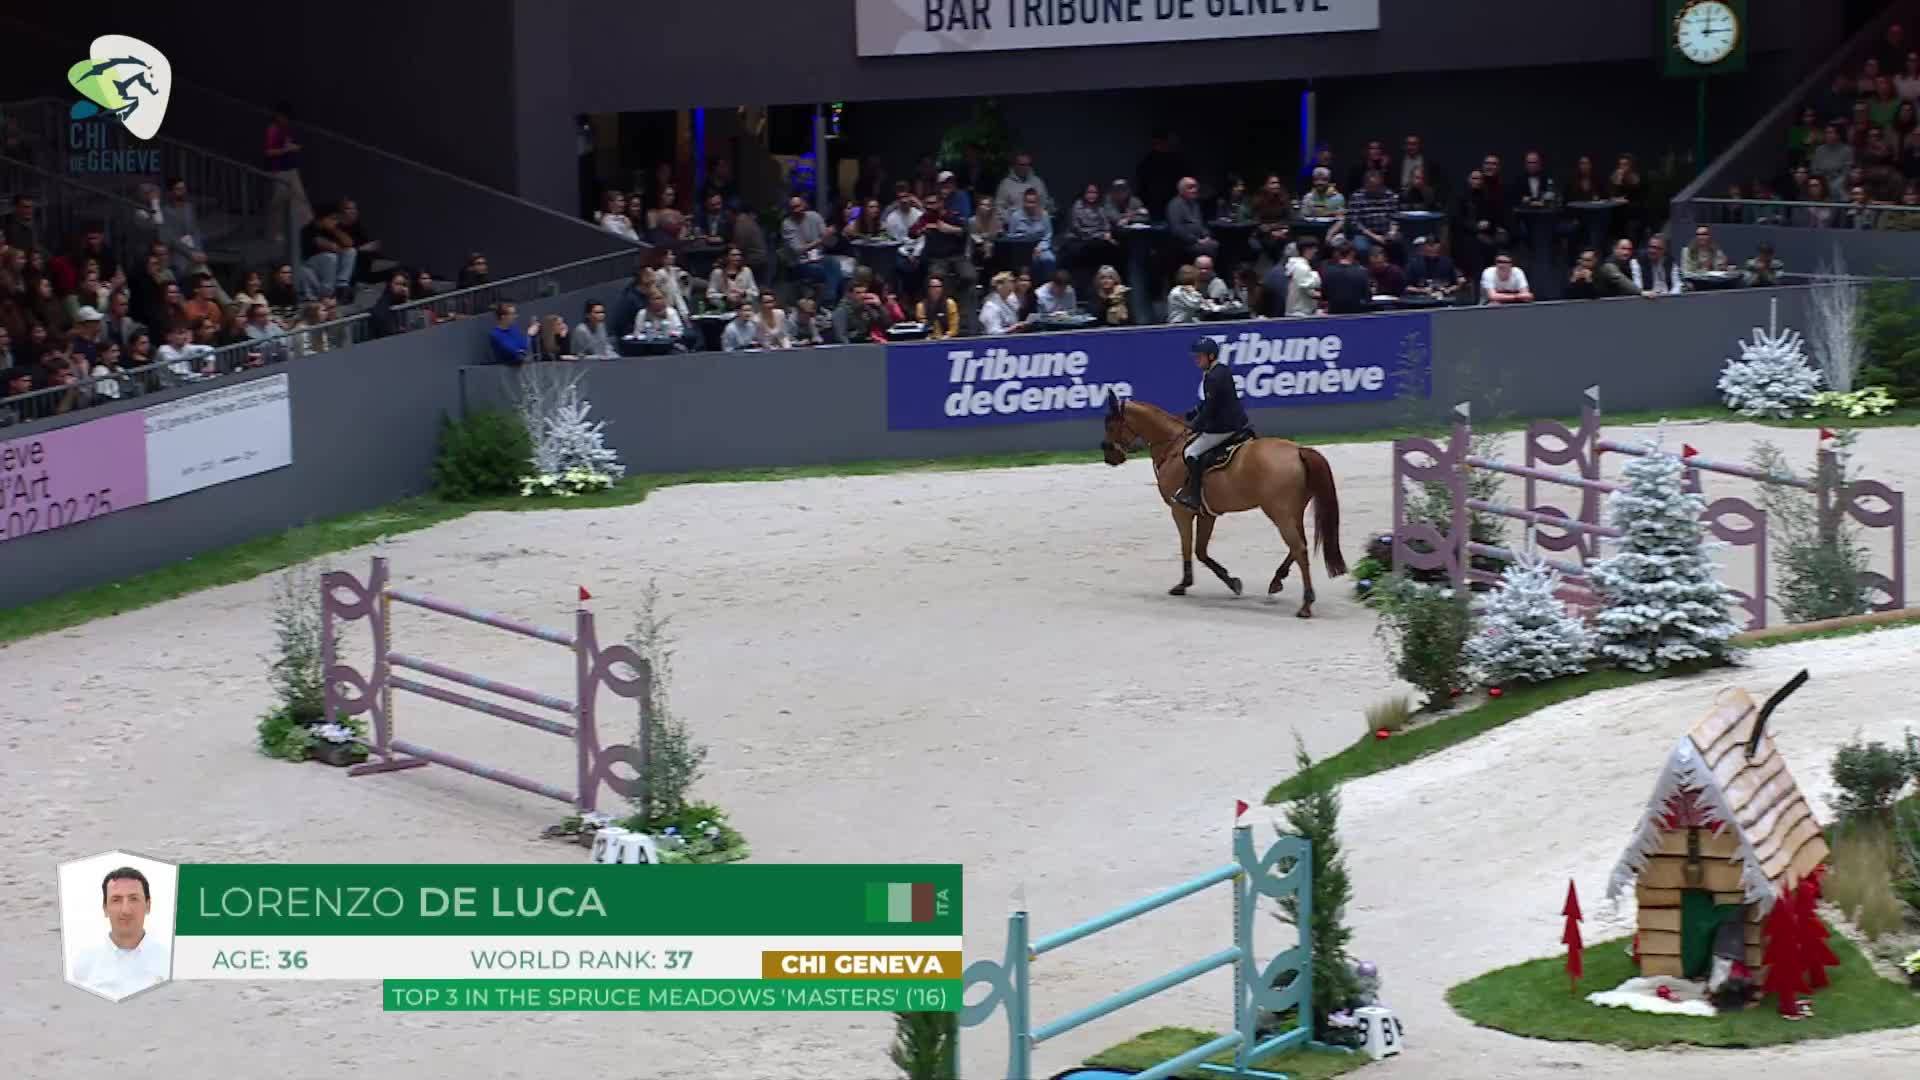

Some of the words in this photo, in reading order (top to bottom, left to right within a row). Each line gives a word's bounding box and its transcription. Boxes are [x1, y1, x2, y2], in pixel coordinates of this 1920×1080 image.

[924, 0, 992, 32] BAR
[1008, 0, 1143, 28] TRIBUNE
[948, 348, 1089, 383] Tribune
[1198, 360, 1385, 400] eGenève
[944, 376, 1133, 417] deGenève
